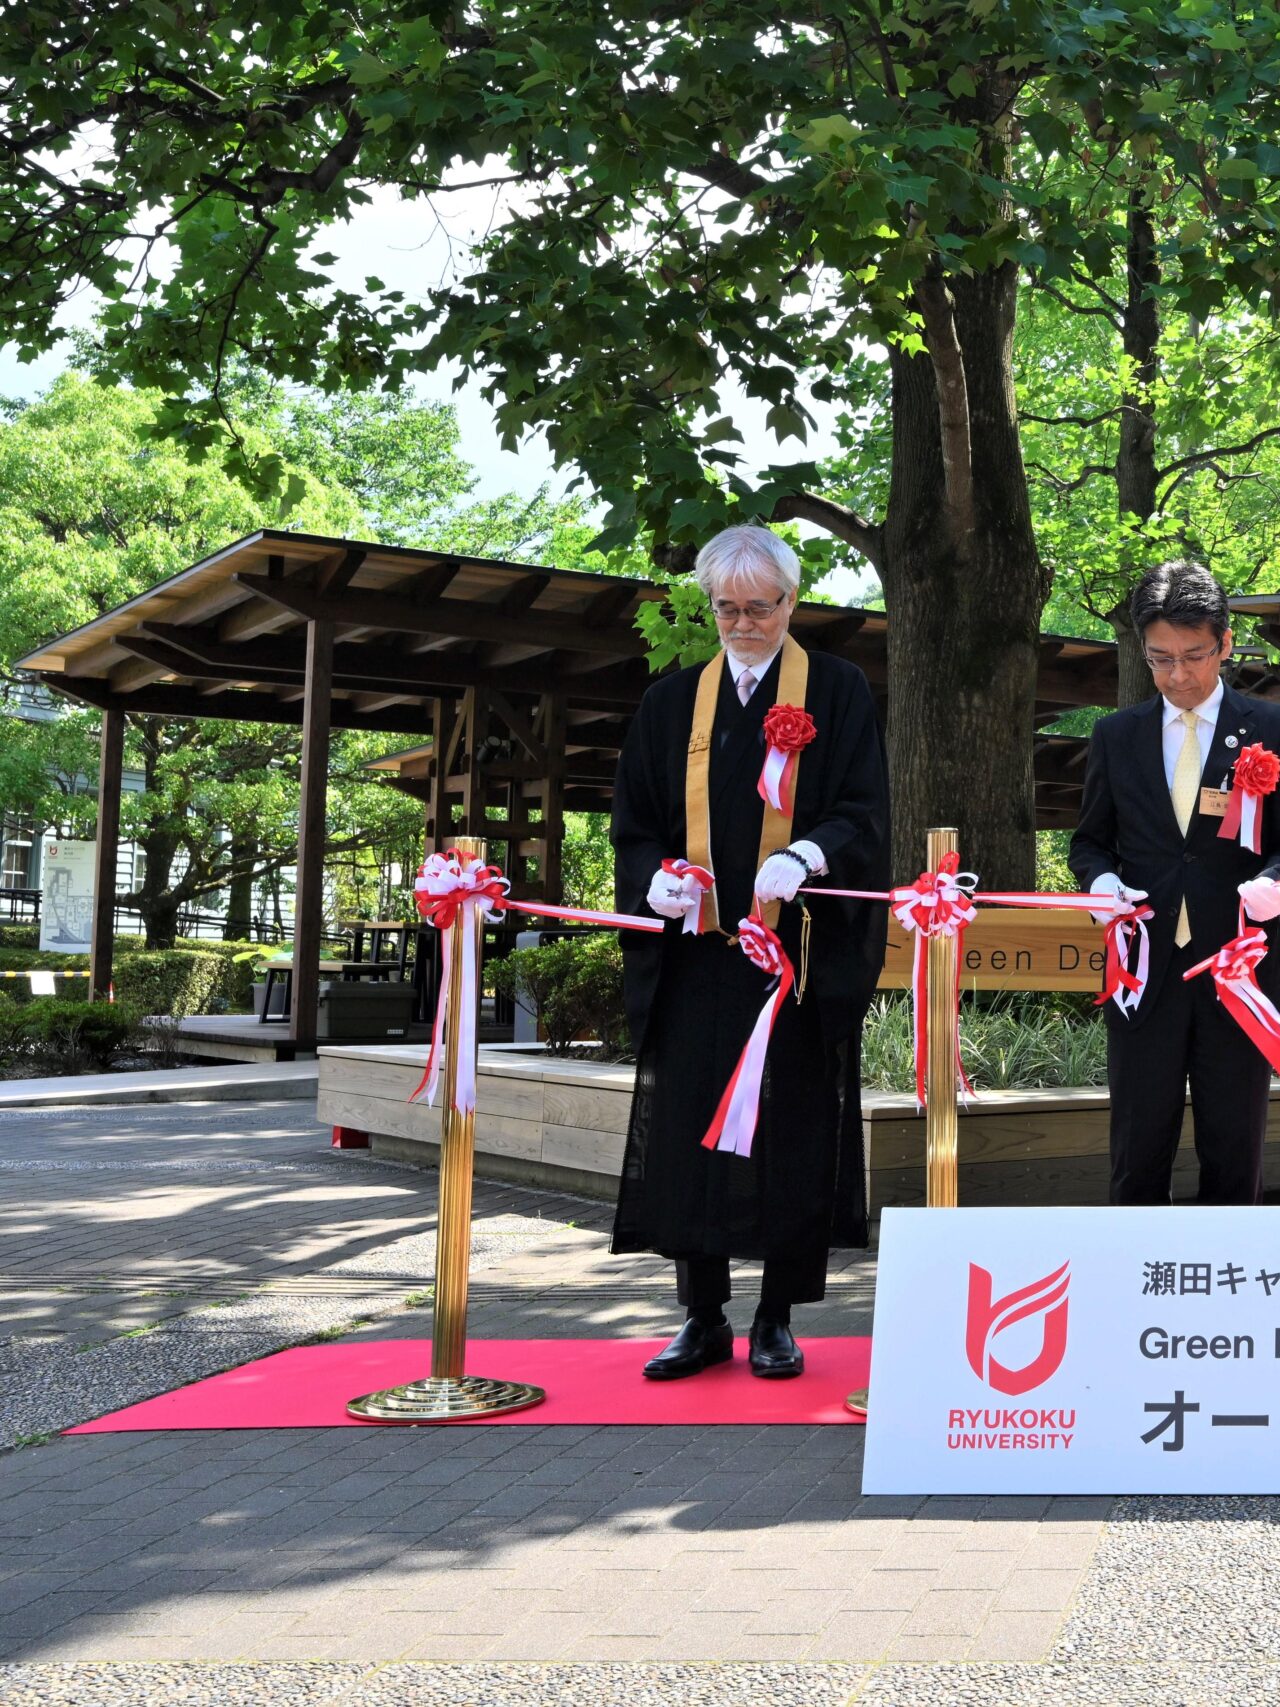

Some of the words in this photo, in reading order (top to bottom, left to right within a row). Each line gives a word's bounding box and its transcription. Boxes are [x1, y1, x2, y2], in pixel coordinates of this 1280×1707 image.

[965, 948, 1032, 970] een
[1058, 944, 1105, 971] De
[1139, 1326, 1255, 1360] Green
[948, 1408, 1077, 1430] RYUKOKU
[947, 1433, 1075, 1450] UNIVERSITY
